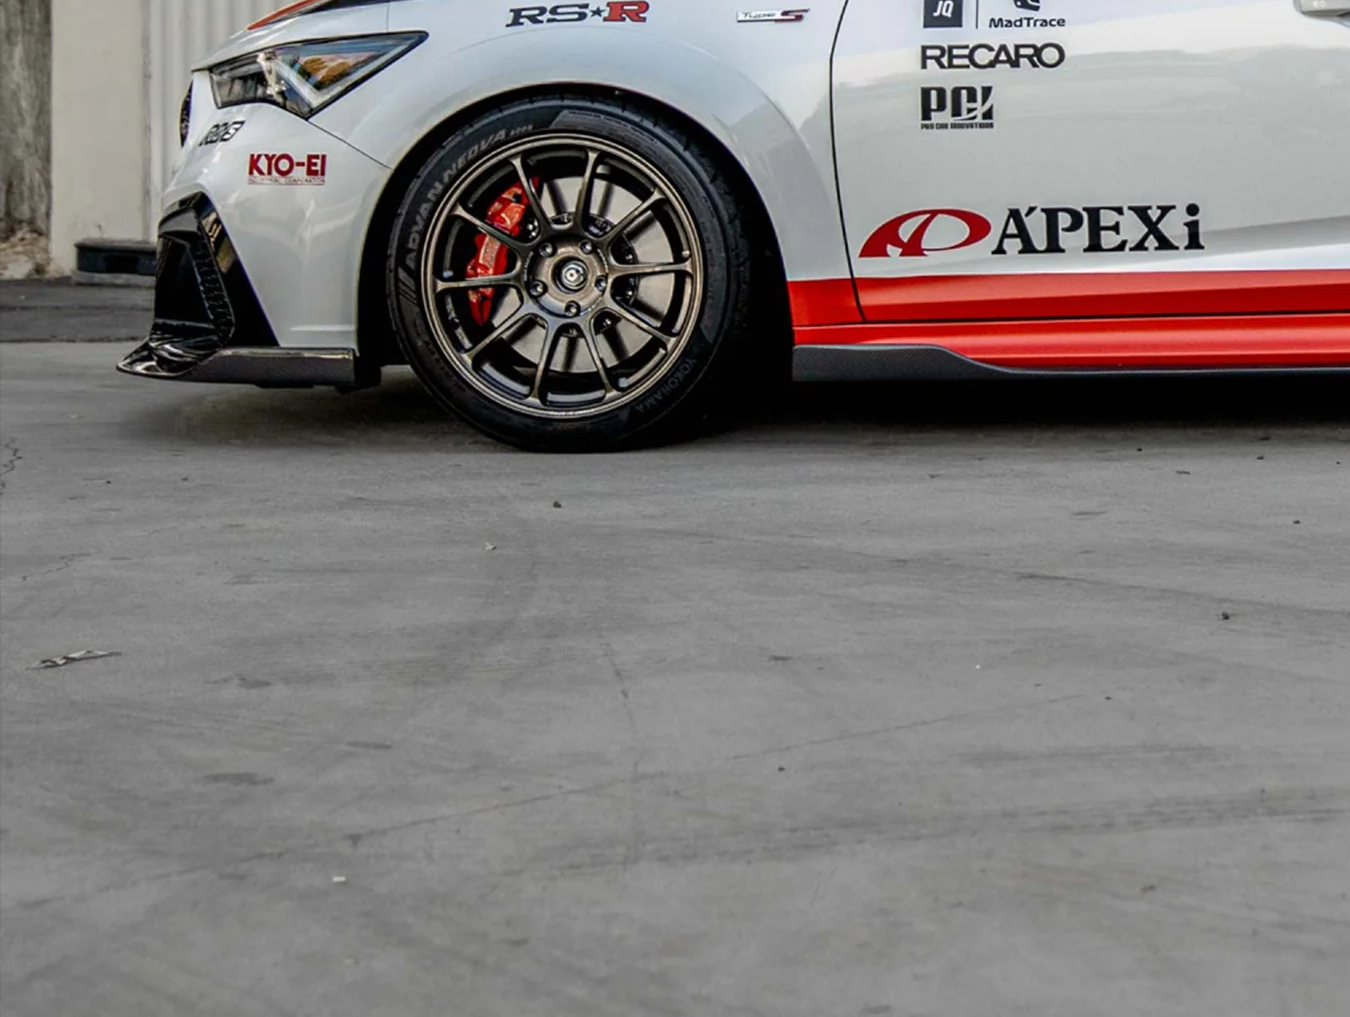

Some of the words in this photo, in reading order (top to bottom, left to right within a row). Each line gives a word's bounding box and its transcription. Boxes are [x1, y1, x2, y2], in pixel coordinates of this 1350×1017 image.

[776, 8, 810, 23] S
[933, 0, 954, 17] JQ
[989, 17, 1066, 28] MadTrace
[921, 42, 1065, 69] RECARO
[921, 86, 993, 121] PCI
[248, 153, 326, 177] KYO-EI
